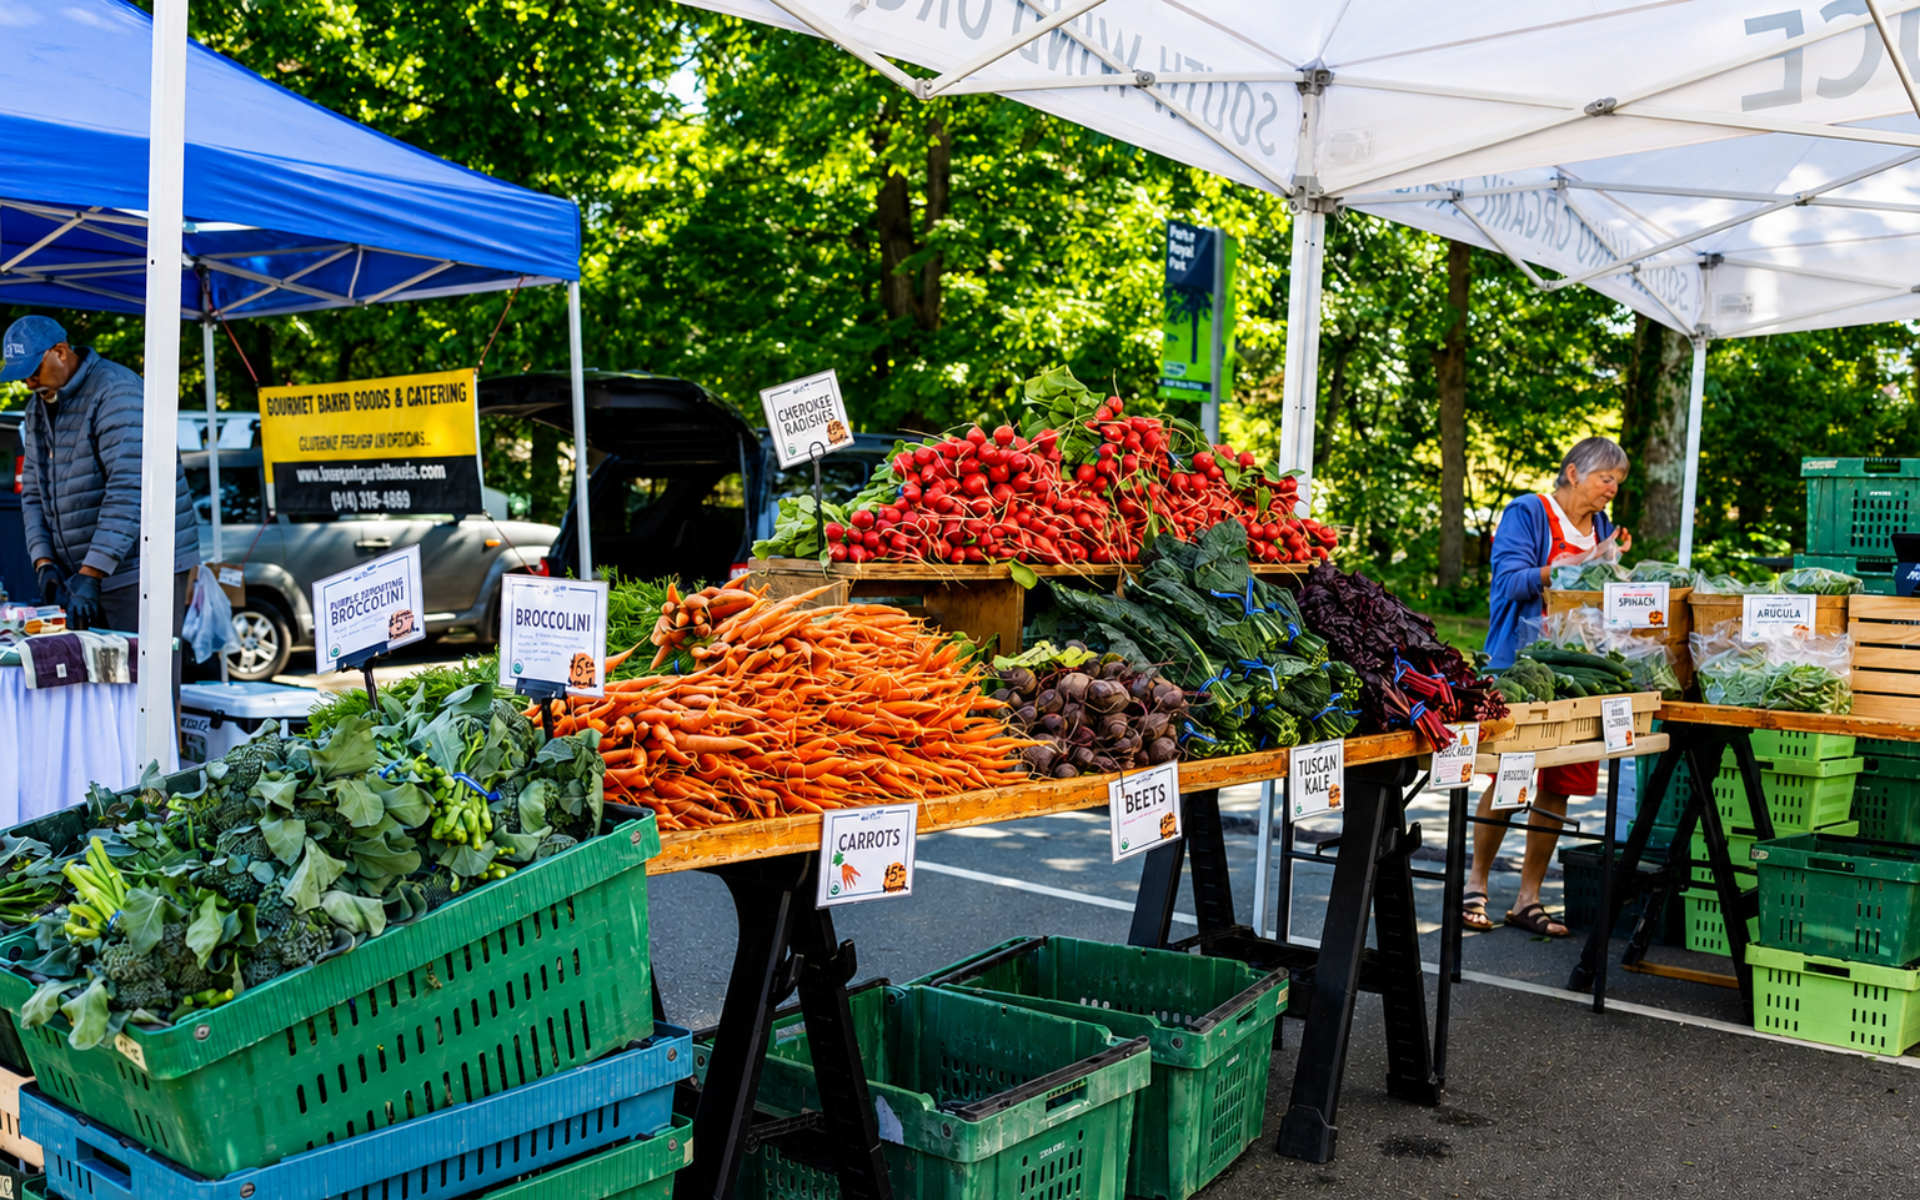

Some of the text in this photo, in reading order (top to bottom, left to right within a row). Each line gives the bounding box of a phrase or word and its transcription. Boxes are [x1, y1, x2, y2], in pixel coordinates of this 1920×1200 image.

[354, 388, 391, 411] GOODS
[395, 387, 403, 407] &
[406, 382, 467, 407] CATERING
[331, 585, 404, 627] BROCCOLINI
[516, 607, 591, 633] BROCCOLINI
[1298, 753, 1337, 777] TUSCAN
[1305, 774, 1330, 796] KALE
[1125, 783, 1166, 815] BEETS
[838, 828, 901, 852] CARROTS
